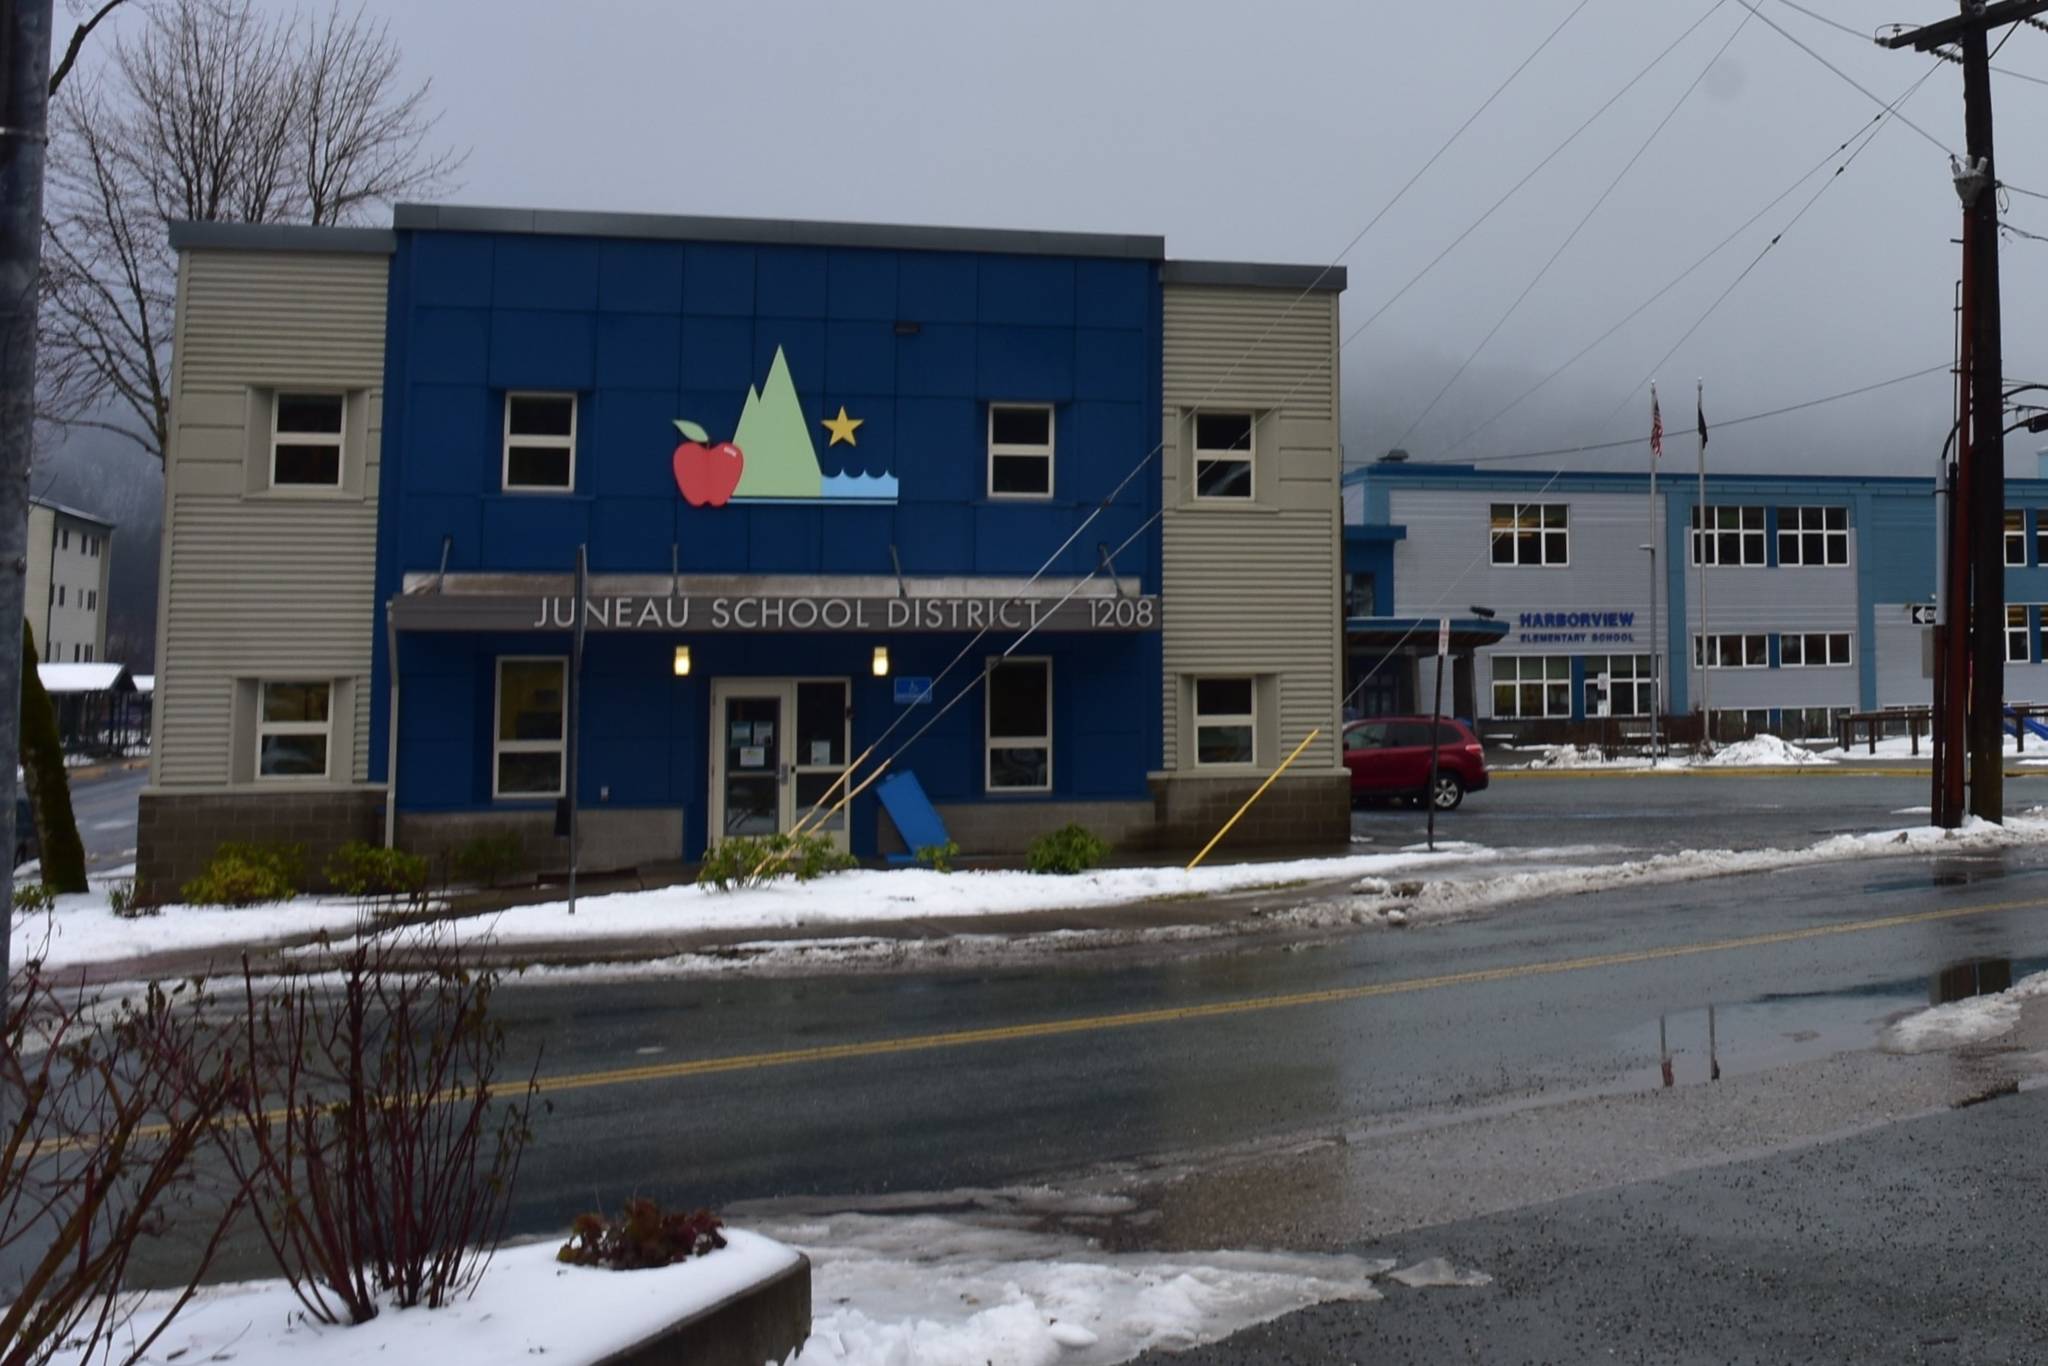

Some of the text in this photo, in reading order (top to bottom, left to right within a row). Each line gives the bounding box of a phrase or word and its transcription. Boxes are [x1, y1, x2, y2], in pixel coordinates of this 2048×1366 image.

[533, 596, 1154, 628] JUNEAU SCHOOL DISTRICT 1208
[1519, 611, 1635, 628] HARBORVIEW
[1520, 632, 1634, 643] ELEMENTARY SCHOOL
